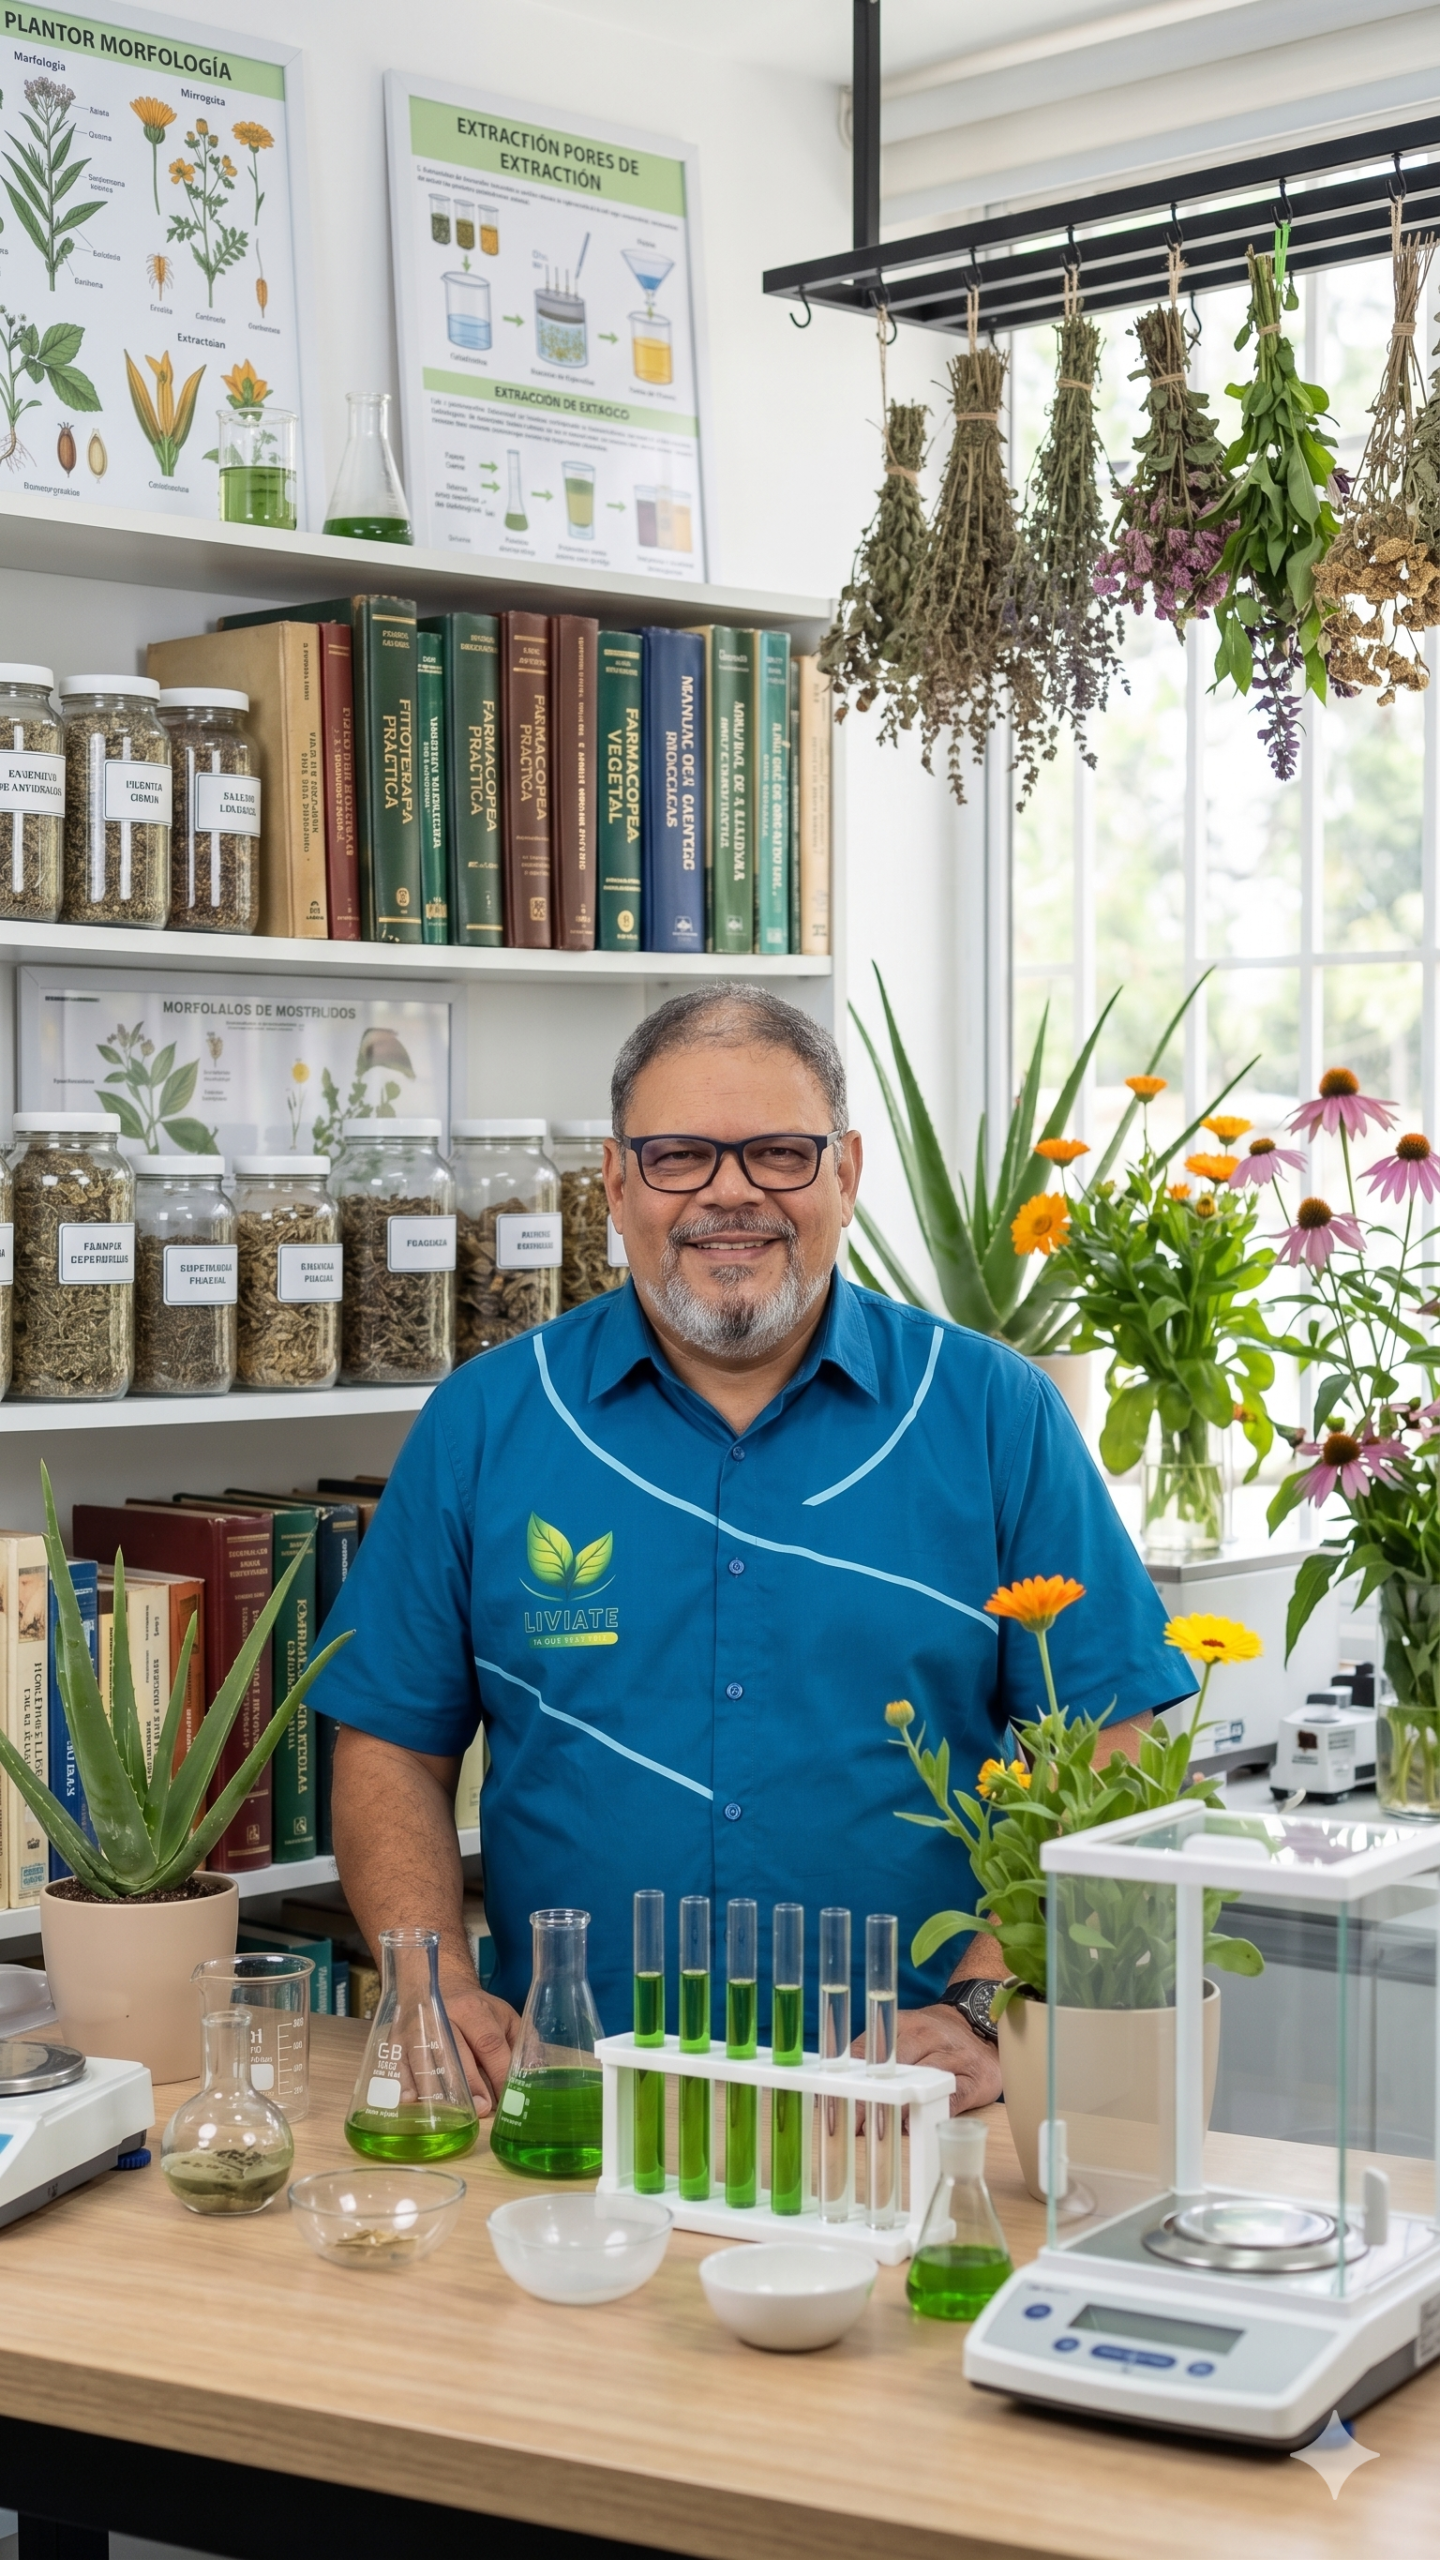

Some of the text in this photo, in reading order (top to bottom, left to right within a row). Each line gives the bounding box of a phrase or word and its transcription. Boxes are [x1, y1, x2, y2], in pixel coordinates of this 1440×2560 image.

[5, 10, 232, 81] PLANTOR MORFOLOGÍA
[563, 142, 614, 170] PORES
[618, 157, 640, 176] DE
[563, 399, 577, 411] DE
[468, 726, 484, 815] PRACTICA
[483, 699, 498, 832] FARMACOPEA
[534, 694, 548, 820] FARMACOPEA
[608, 729, 623, 824] VEGETAL
[626, 707, 640, 843] FARMACOPEA
[256, 1004, 272, 1016] DE
[524, 1608, 618, 1633] LIVIATE
